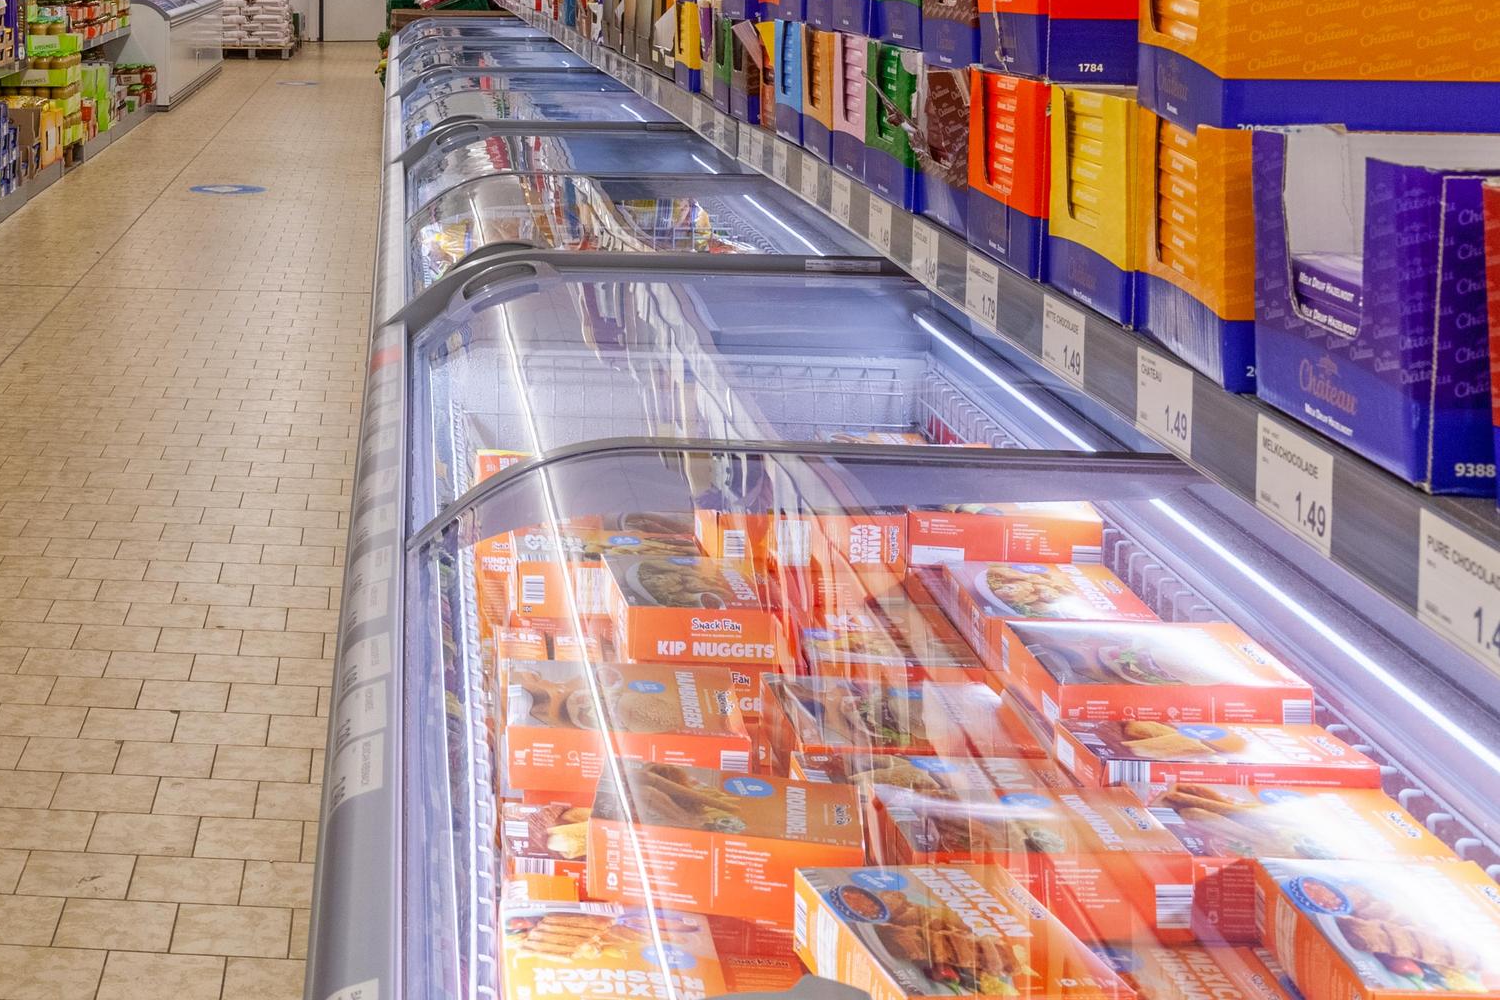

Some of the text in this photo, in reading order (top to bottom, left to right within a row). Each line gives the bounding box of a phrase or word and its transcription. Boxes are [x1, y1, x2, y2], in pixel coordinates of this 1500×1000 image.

[1077, 63, 1103, 74] 1784
[981, 293, 996, 321] 1.79
[1063, 344, 1081, 377] 1.49
[1140, 361, 1163, 384] CHATEAU
[1164, 404, 1188, 441] 1.49
[1262, 437, 1320, 480] MELKCHOCOLADE
[1454, 463, 1497, 479] 9388
[1294, 490, 1327, 538] 1.49
[1427, 534, 1451, 561] PURE
[657, 639, 775, 659] KIP NUGGETS
[909, 867, 998, 939] RIBSNACK
[936, 867, 1035, 939] MEXICAN
